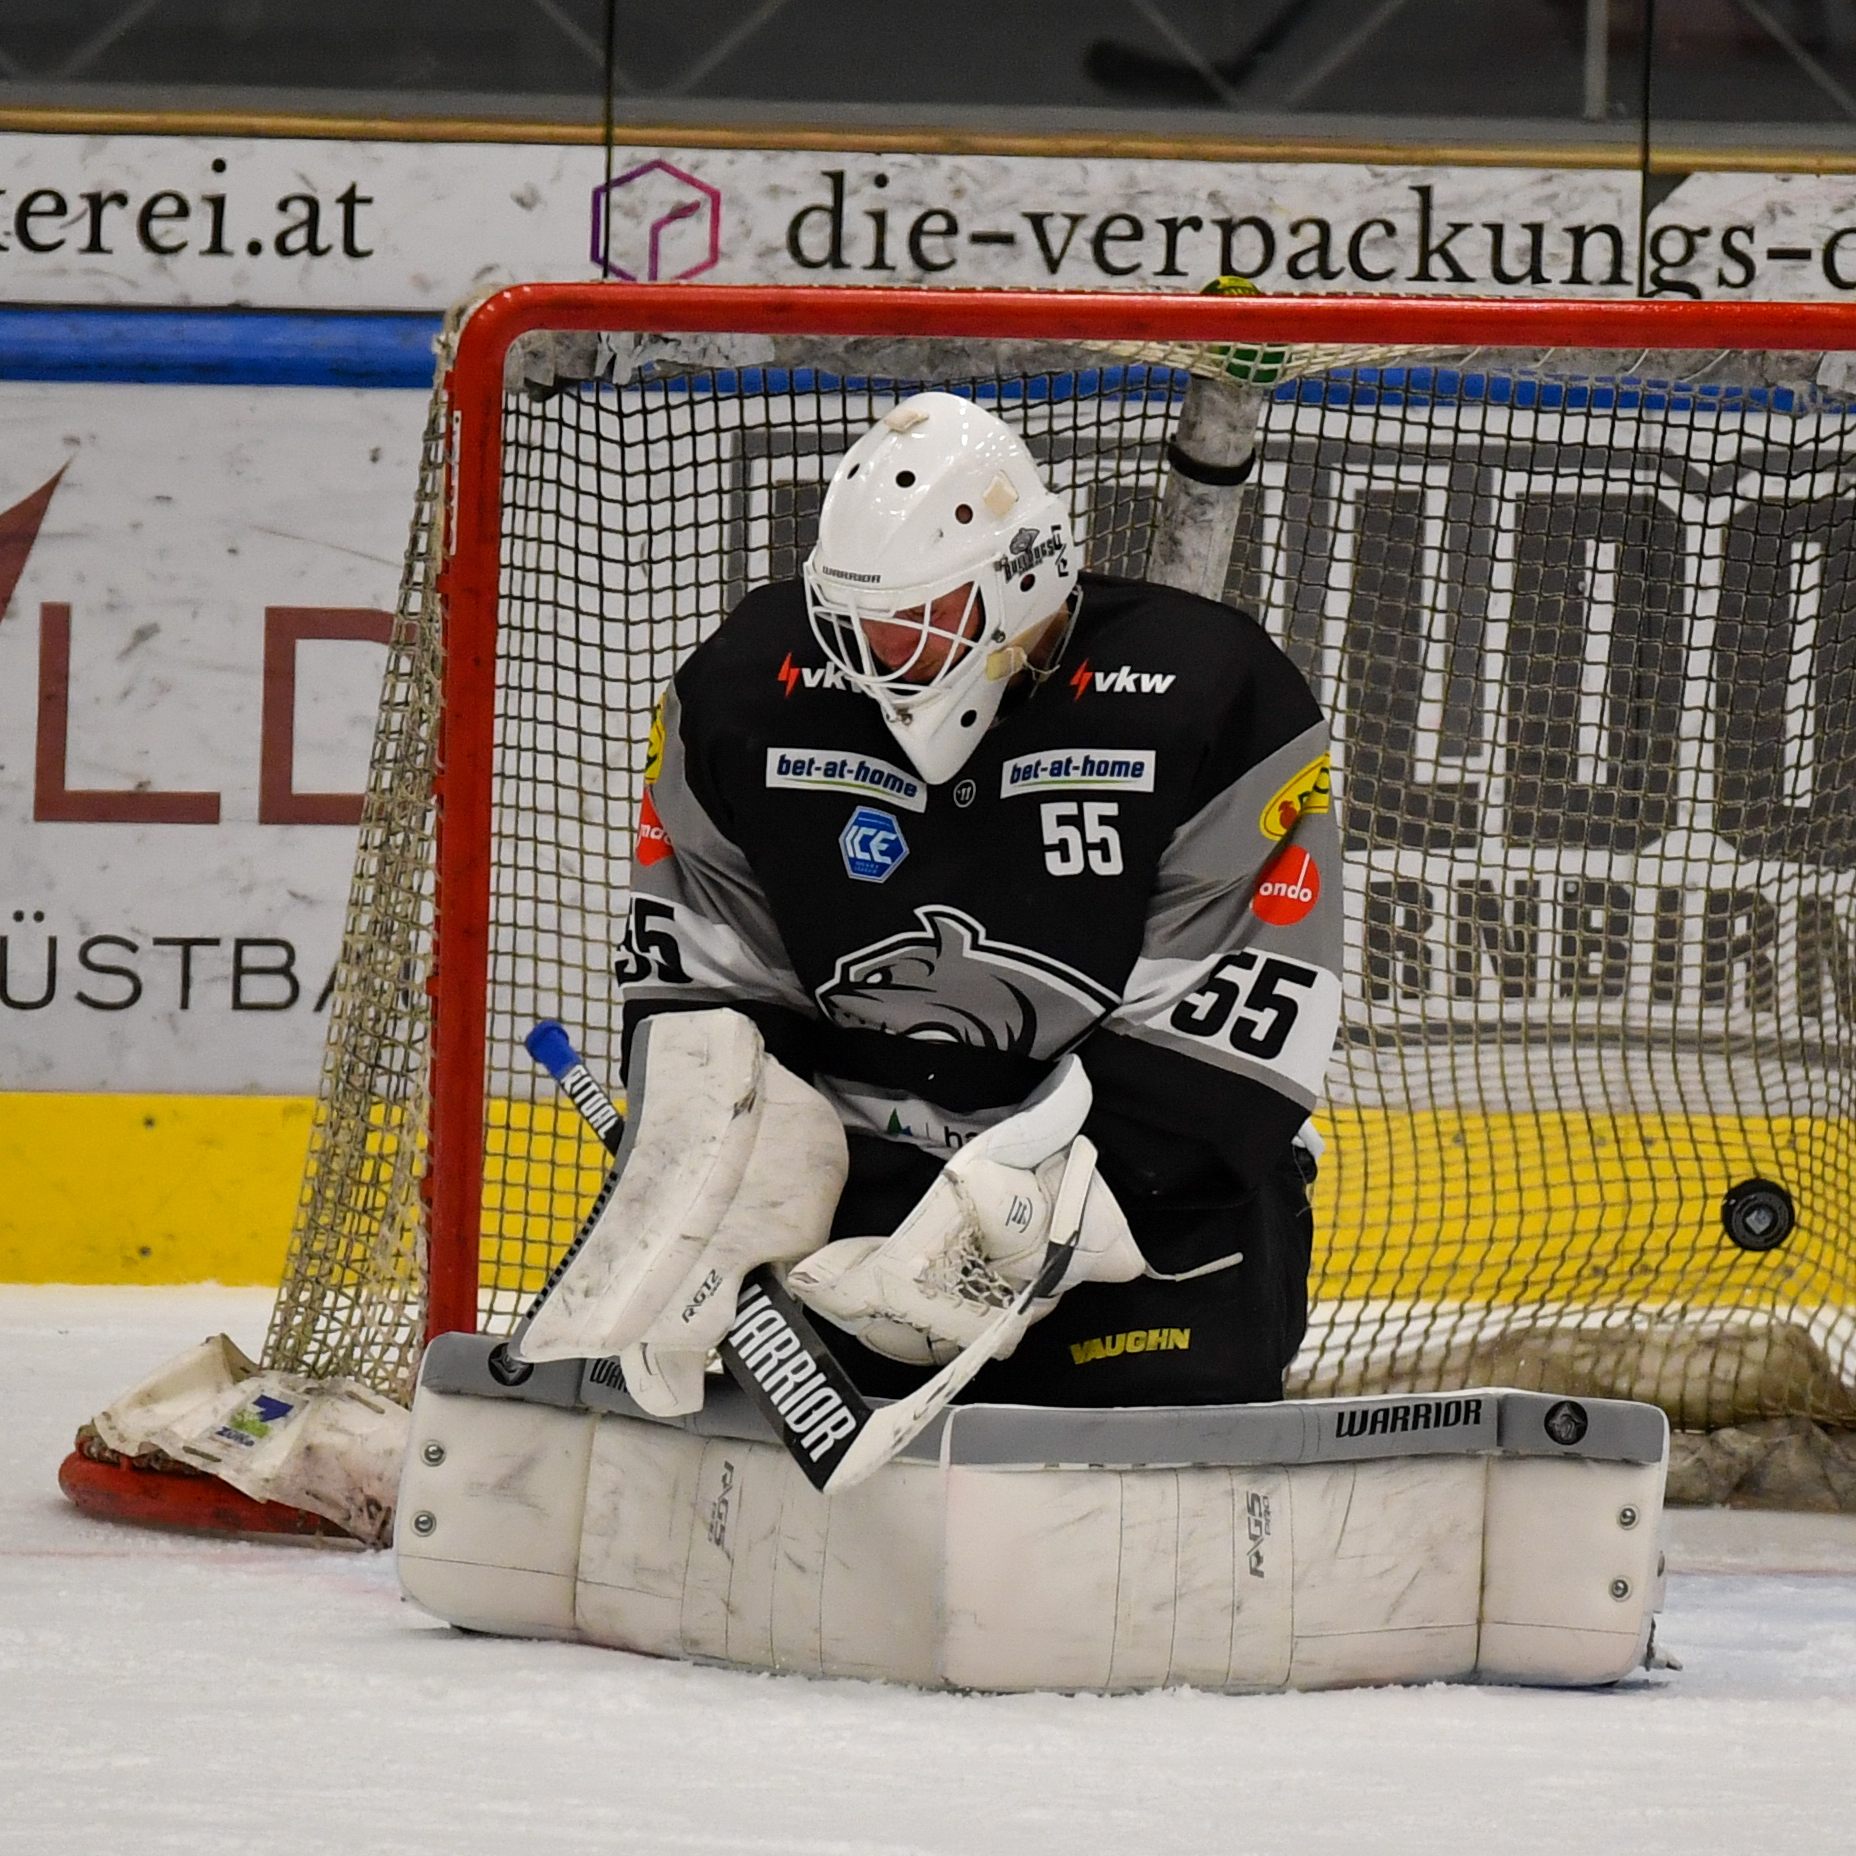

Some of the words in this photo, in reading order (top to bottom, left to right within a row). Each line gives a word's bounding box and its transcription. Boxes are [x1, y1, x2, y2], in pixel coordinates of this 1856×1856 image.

[0, 157, 374, 258] erei.at
[821, 564, 882, 585] WARRIOR
[1093, 665, 1176, 695] vkw
[776, 753, 919, 799] bet-at-home
[1009, 754, 1145, 784] bet-at-home
[845, 825, 898, 865] ICE
[1039, 801, 1124, 877] 55
[1259, 852, 1312, 903] ondo
[1169, 951, 1318, 1060] 55
[560, 1063, 620, 1140] RITUAL
[1068, 1327, 1192, 1366] VAUGHN
[1335, 1398, 1482, 1439] WARRIOR
